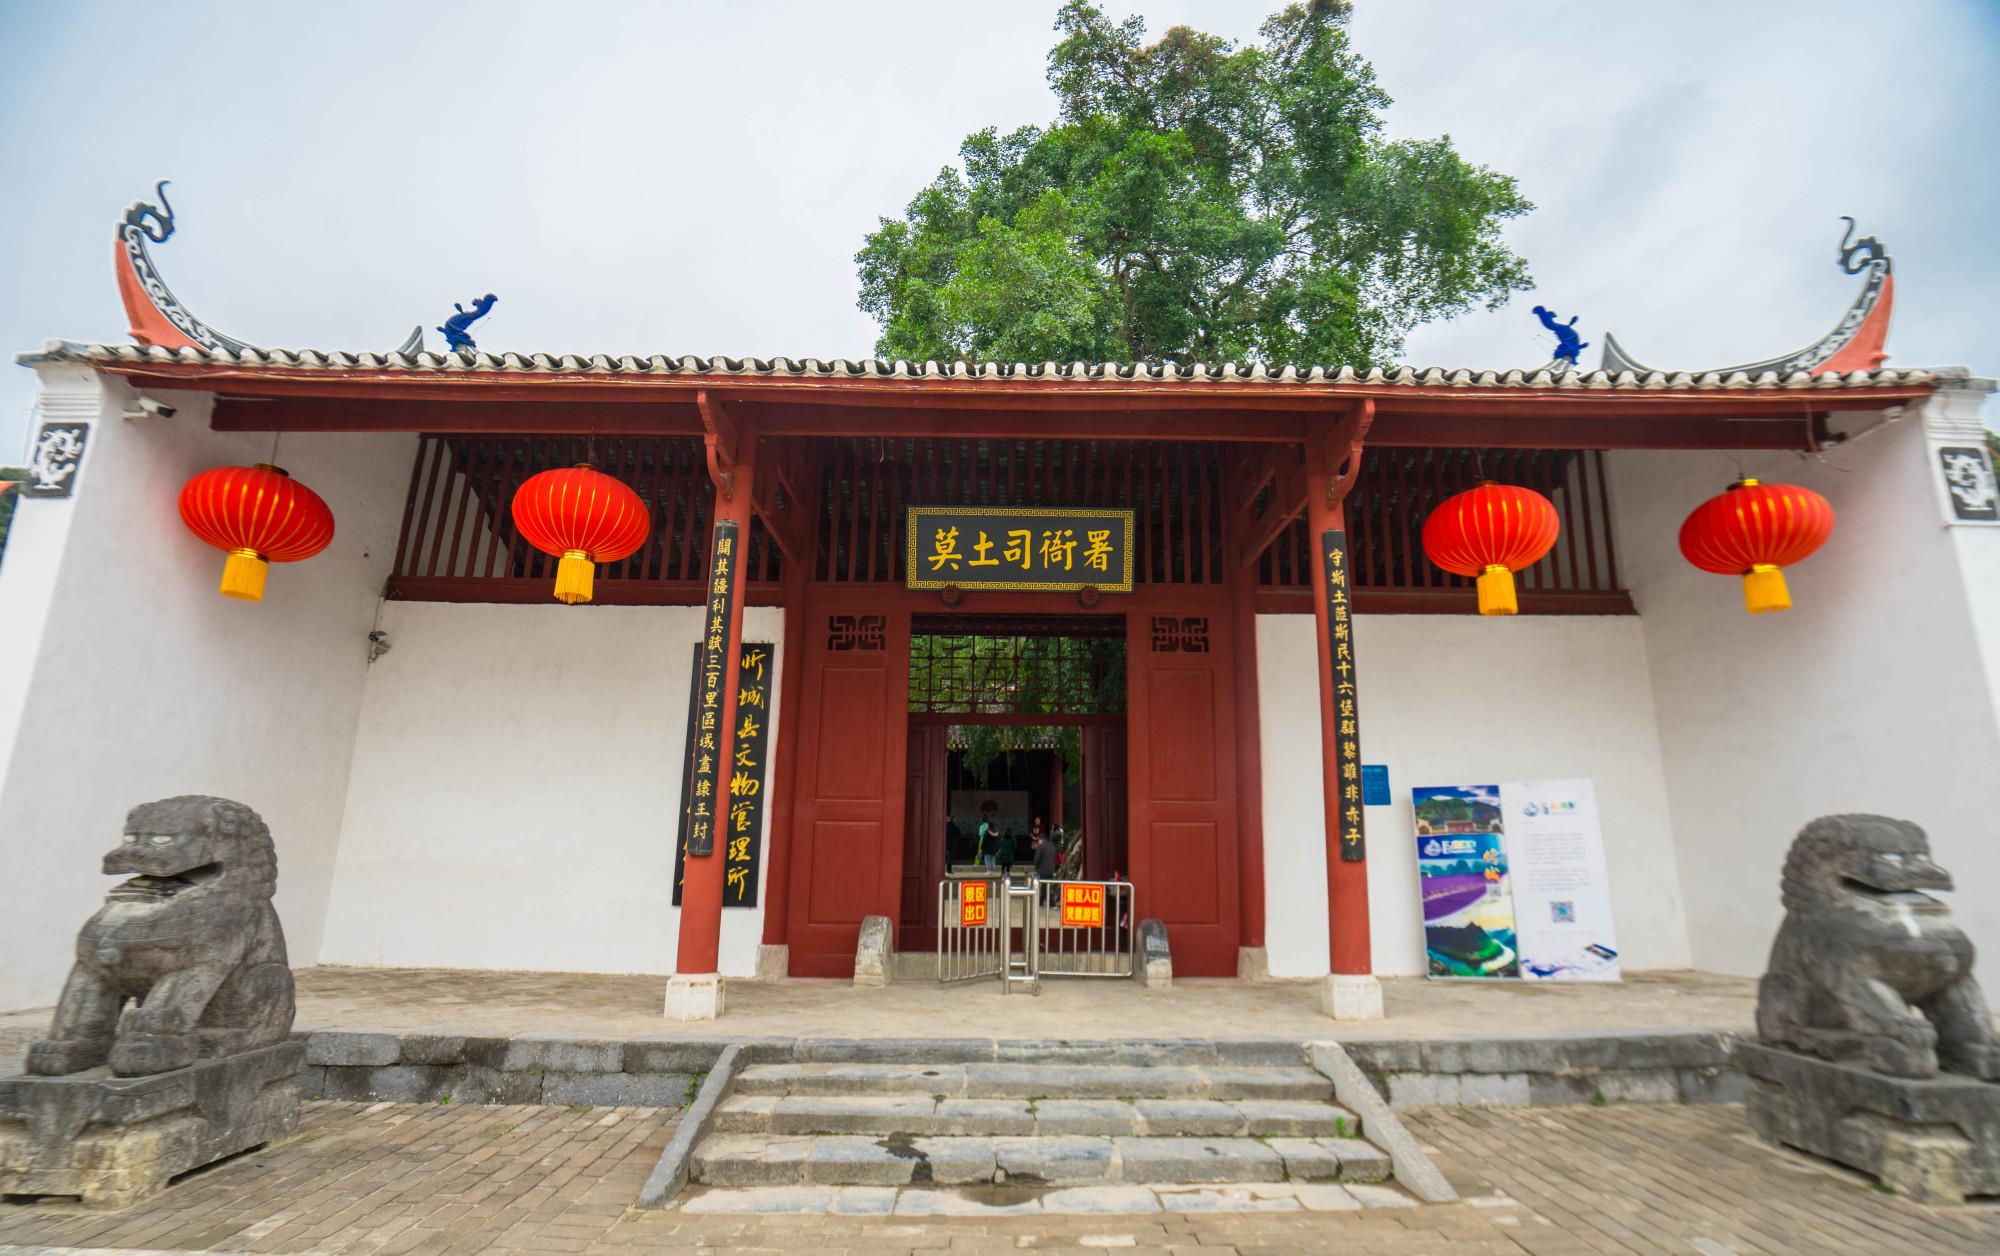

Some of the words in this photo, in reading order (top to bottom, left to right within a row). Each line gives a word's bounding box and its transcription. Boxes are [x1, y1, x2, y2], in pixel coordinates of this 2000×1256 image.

[928, 526, 1114, 571] 莫土司衙署
[728, 649, 766, 901] 忻城县文物管理所
[965, 886, 985, 903] 景区
[964, 905, 985, 921] 出口
